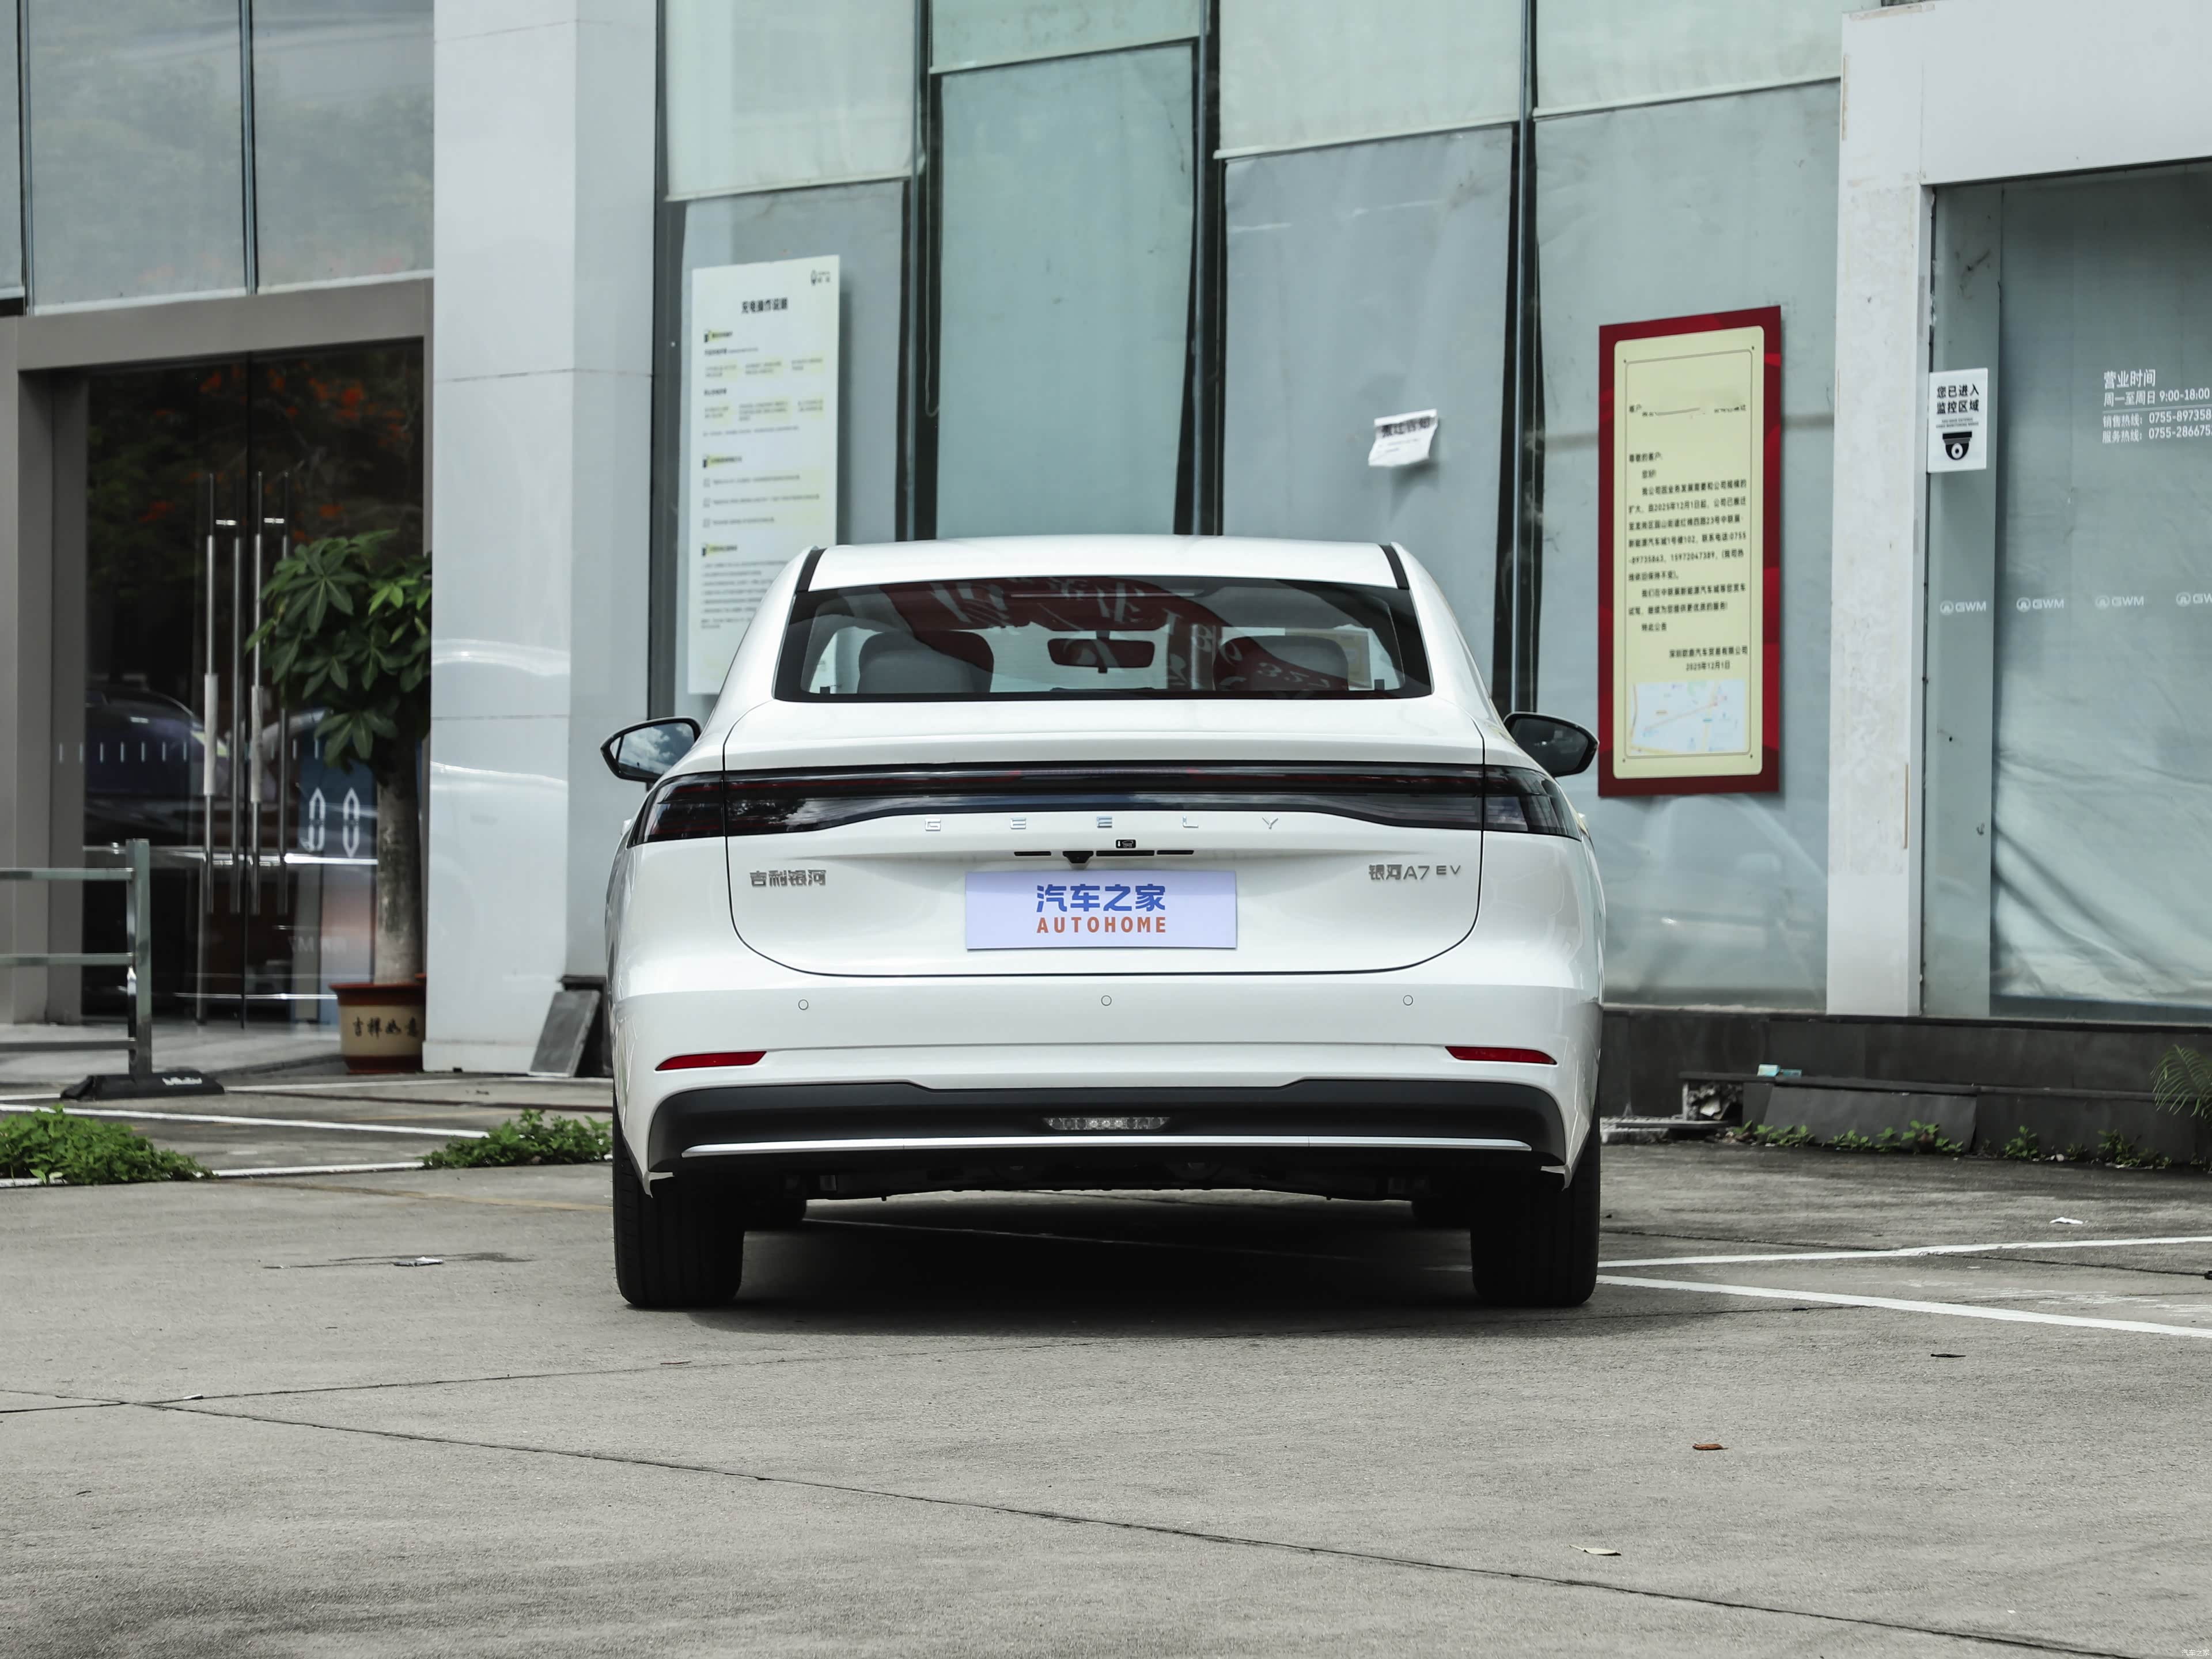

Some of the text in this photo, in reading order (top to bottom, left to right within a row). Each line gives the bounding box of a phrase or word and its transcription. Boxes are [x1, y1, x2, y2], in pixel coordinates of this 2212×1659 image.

[2104, 369, 2156, 390] 营业时间
[1937, 383, 1980, 399] 您已进入
[2104, 387, 2210, 407] 周一至周日 9:00-18:00
[1937, 399, 1979, 415] 监控区域
[2103, 408, 2212, 429] 销售热线： 0755-897358
[2102, 424, 2212, 445] 服务热线： 0755-286675
[1955, 601, 1987, 613] GWM
[2032, 599, 2065, 609] GWM
[2111, 596, 2145, 607] GWM
[925, 816, 1279, 831] GEELY
[749, 869, 827, 887] 吉利银河
[1368, 864, 1461, 881] 银河A7 EV
[1036, 883, 1166, 912] 汽车之家
[1036, 916, 1166, 934] AUTOHOME
[352, 1016, 420, 1039] 吉祥如意
